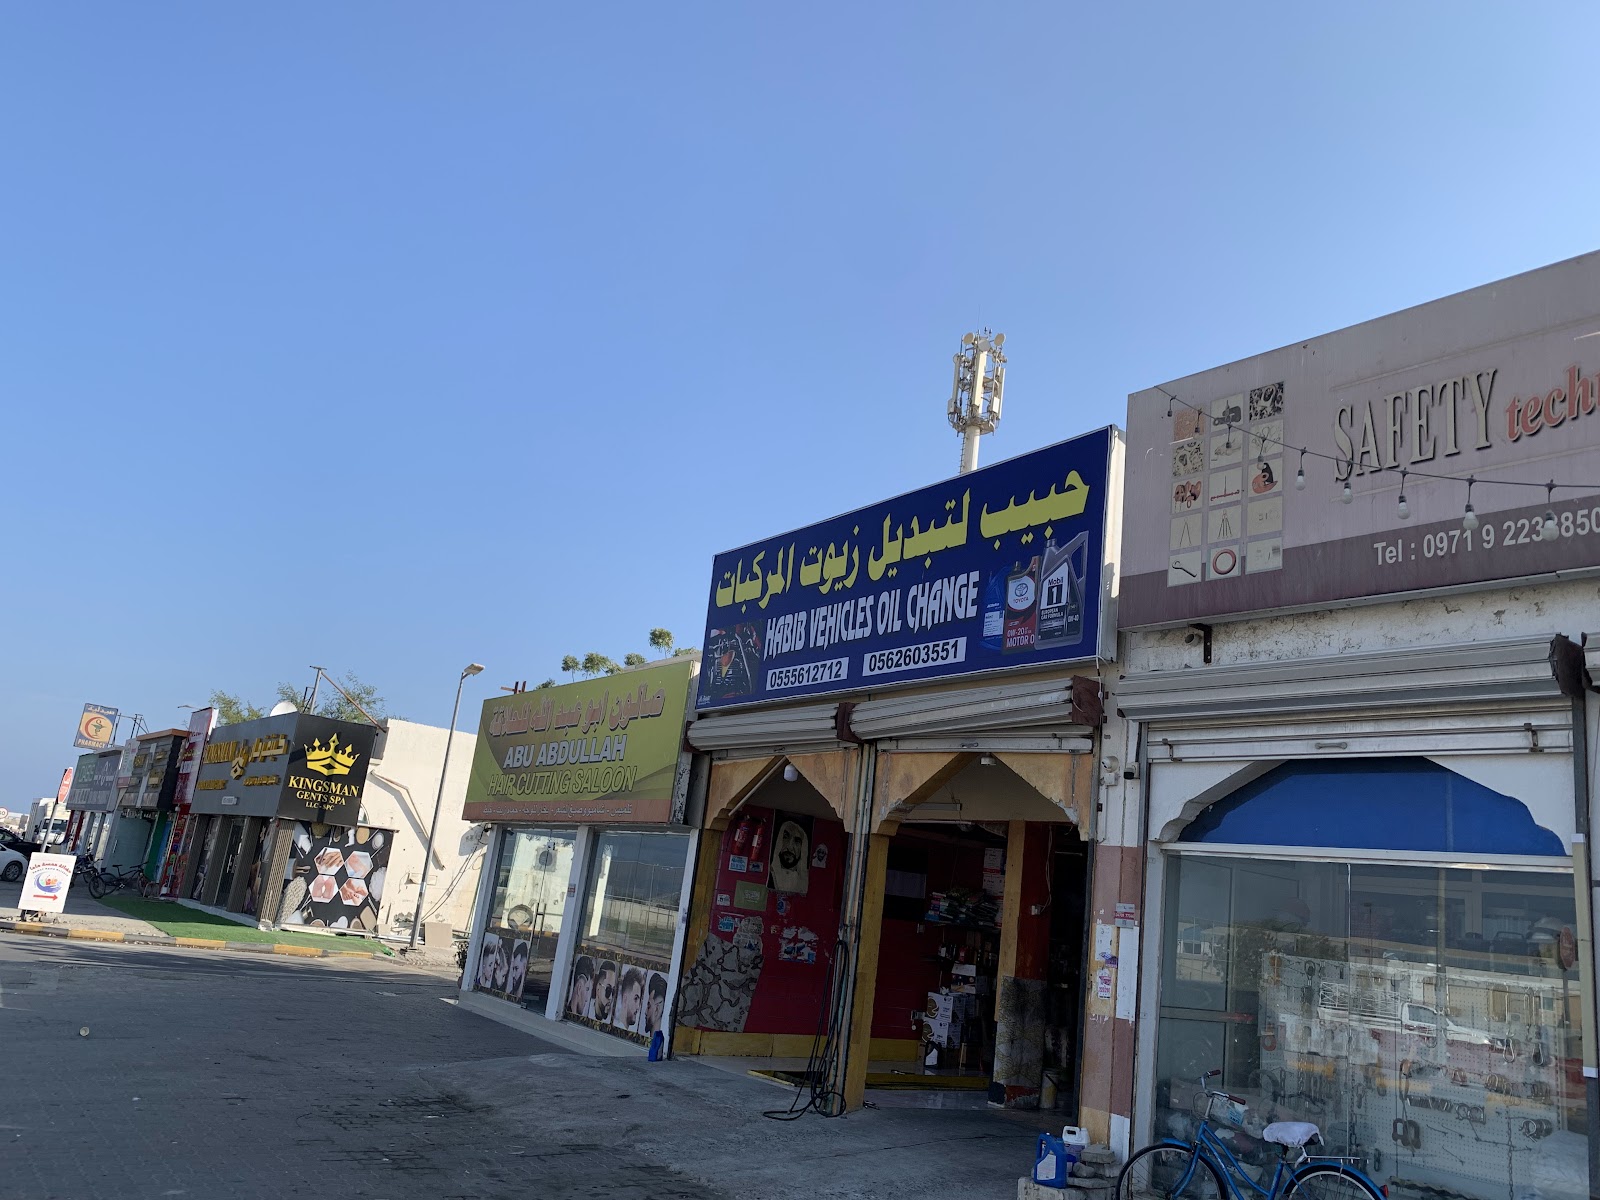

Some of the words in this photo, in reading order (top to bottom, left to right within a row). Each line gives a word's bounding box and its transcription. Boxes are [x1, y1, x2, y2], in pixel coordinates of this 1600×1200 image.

[1334, 367, 1498, 483] SAFETY
[980, 469, 1090, 550] حبيب
[867, 487, 971, 581] لتبديل
[1373, 538, 1403, 565] Tel
[1423, 528, 1472, 558] 0971
[1482, 524, 1495, 549] 9
[1502, 506, 1600, 547] 223850
[715, 541, 796, 614] المركبات
[800, 524, 860, 595] زيوت
[1048, 576, 1064, 586] Mobil
[764, 610, 807, 661] HABIB
[809, 594, 874, 650] VEHICLES
[876, 588, 902, 636] OIL
[906, 570, 980, 633] CHANGE
[1013, 596, 1029, 604] TOYOTA
[868, 639, 959, 672] 0562603551
[1006, 635, 1029, 648] MOTOR
[770, 660, 843, 689] 0555612712
[489, 701, 532, 737] للحلاقة
[530, 695, 555, 732] الله
[554, 699, 583, 737] عبد
[582, 688, 609, 734] ابو
[609, 682, 666, 731] صالون
[77, 738, 106, 749] PHARMACY
[503, 744, 535, 769] ABU
[536, 734, 628, 767] ABDULLAH
[288, 775, 360, 798] KINGSMAN
[296, 790, 329, 803] GENTS
[329, 795, 346, 806] SPA
[487, 772, 517, 796] HAIR
[516, 769, 572, 795] CUTTING
[571, 765, 638, 794] SALOON
[305, 801, 319, 809] LLC
